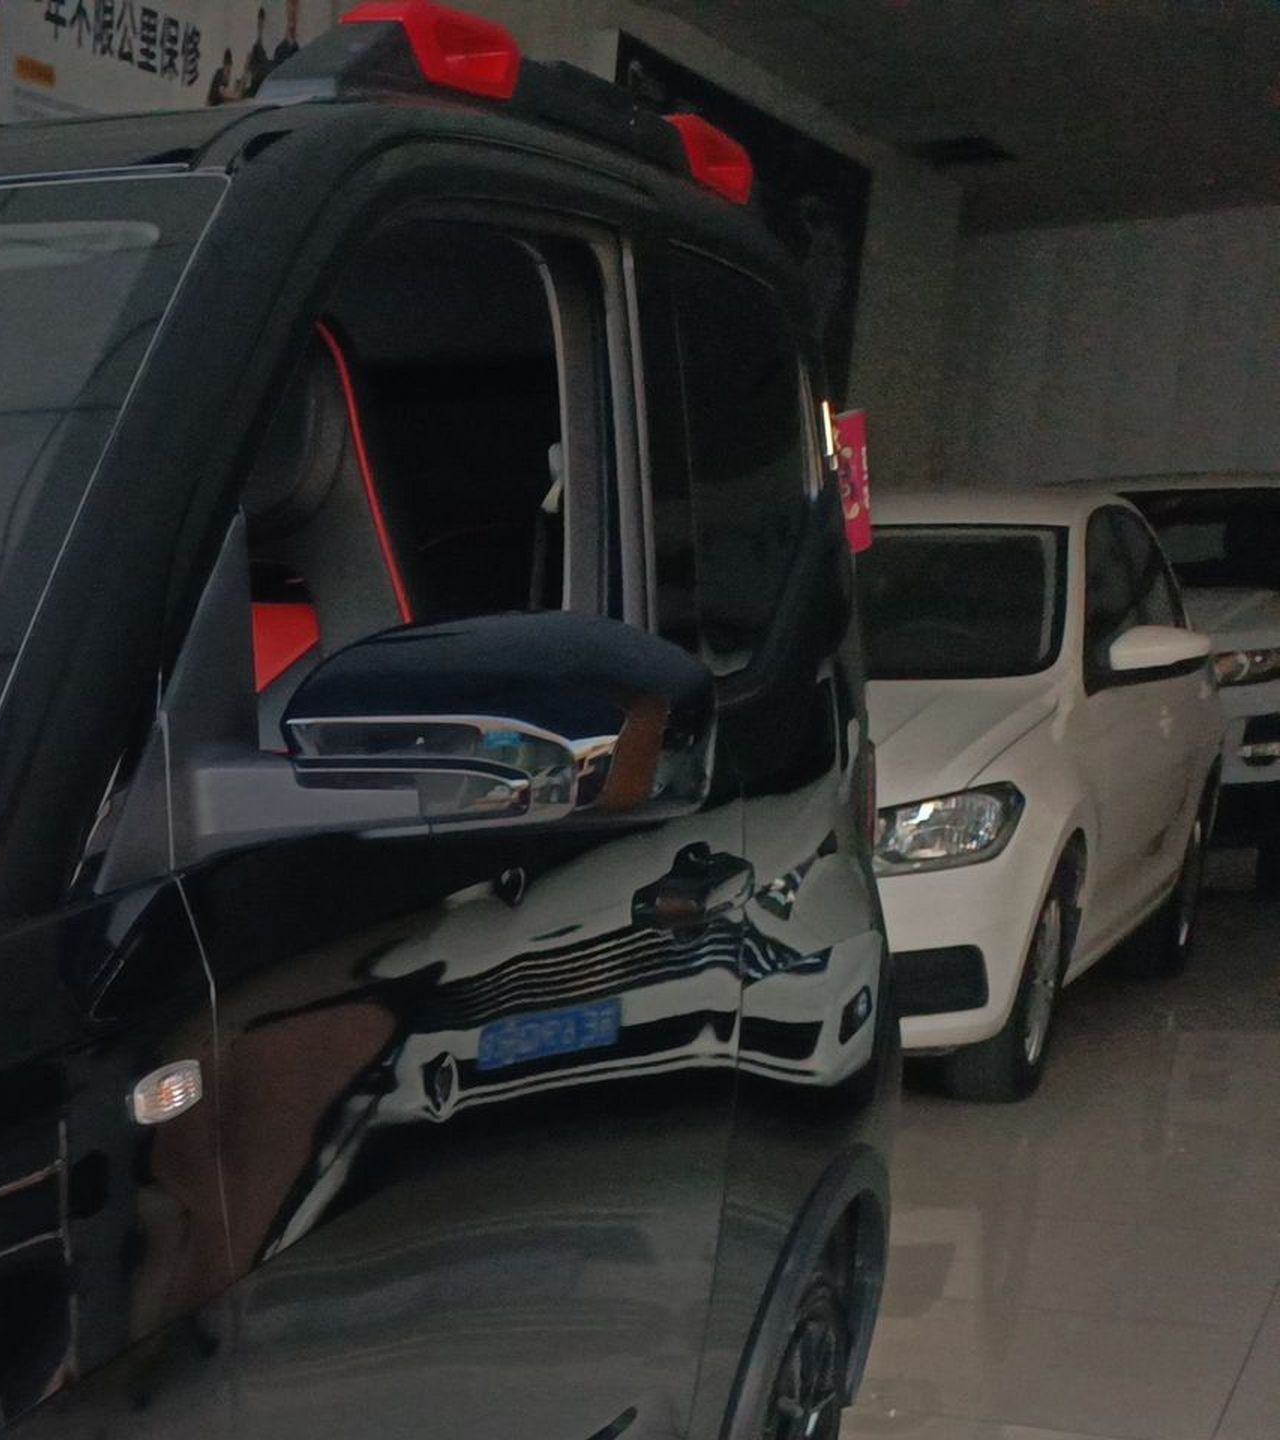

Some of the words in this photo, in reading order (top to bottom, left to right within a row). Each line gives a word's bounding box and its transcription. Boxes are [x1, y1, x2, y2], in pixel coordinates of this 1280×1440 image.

[34, 0, 201, 86] 年不限公里保修
